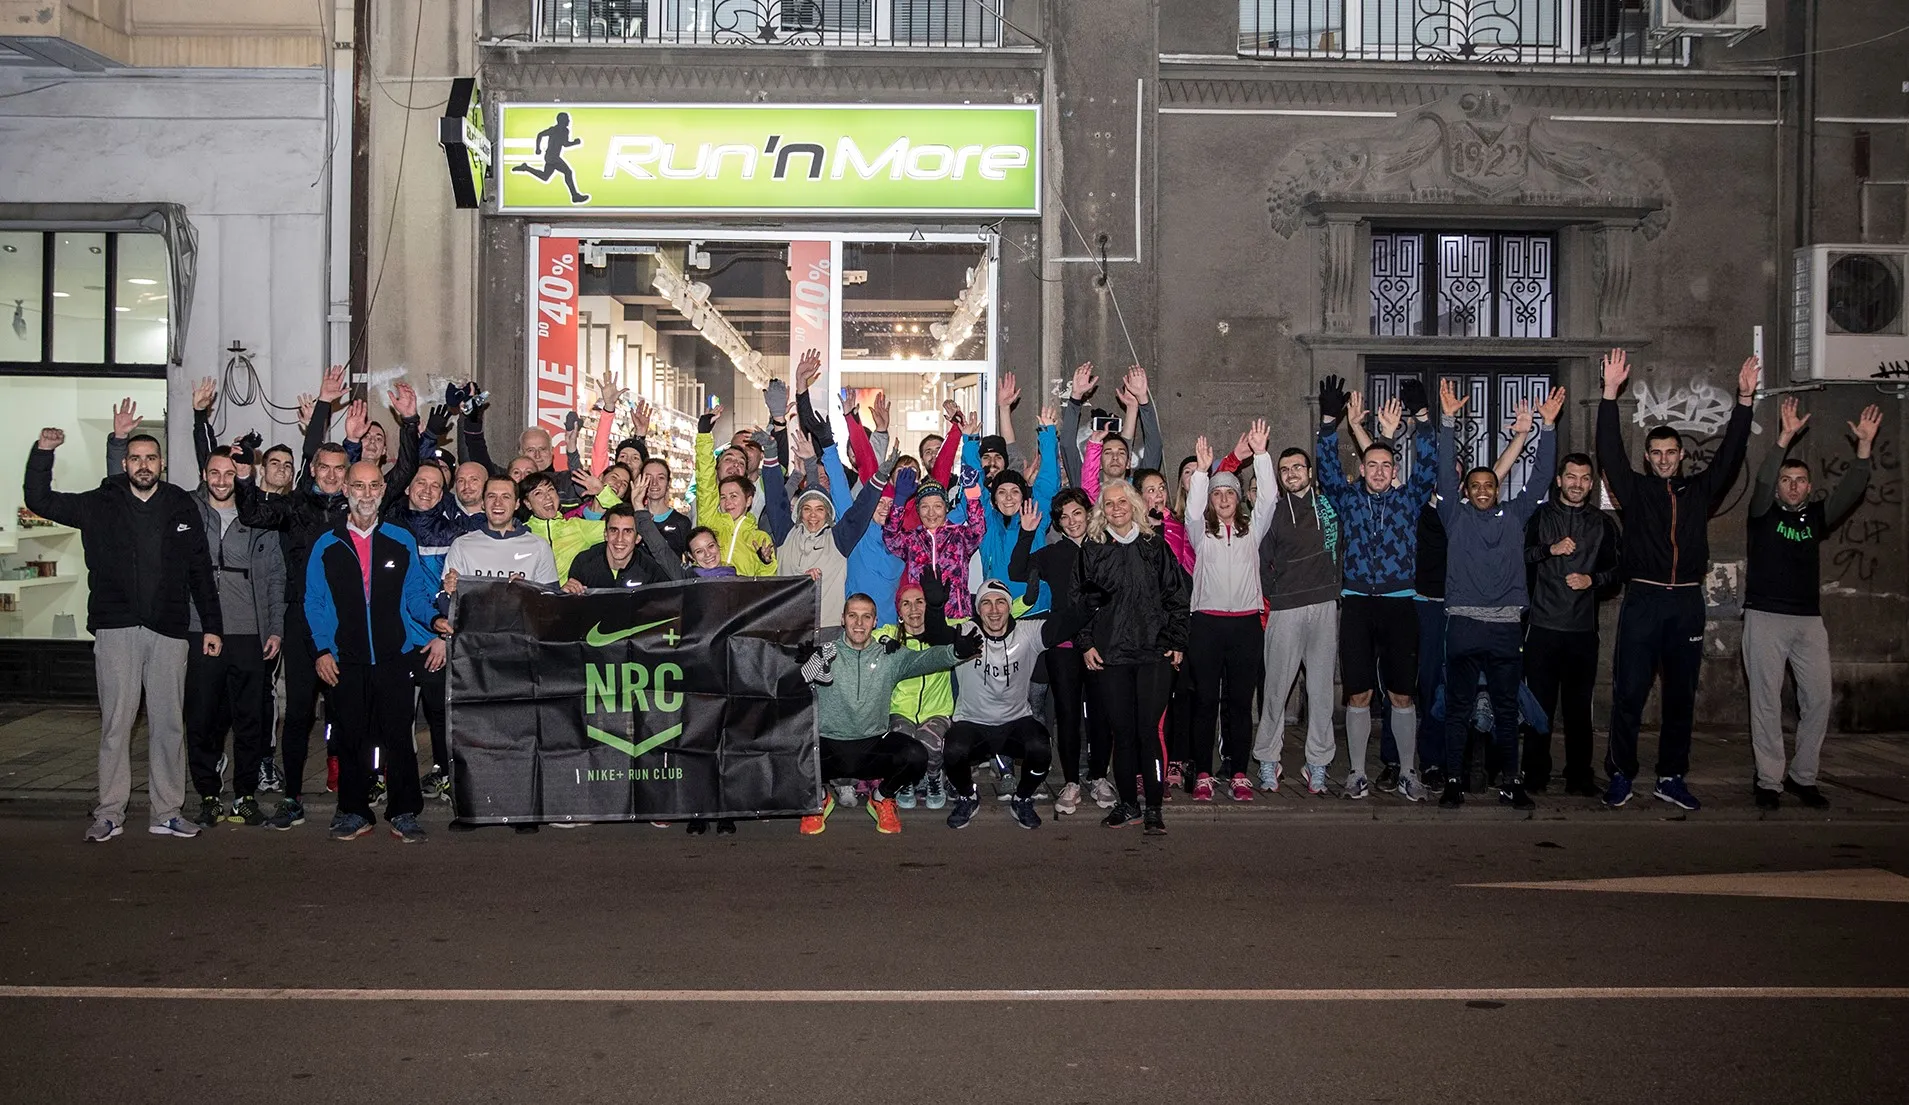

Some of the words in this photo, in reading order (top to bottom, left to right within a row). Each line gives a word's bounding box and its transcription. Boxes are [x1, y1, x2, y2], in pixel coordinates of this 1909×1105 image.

[538, 253, 574, 325] 40%
[795, 258, 830, 330] 40%
[538, 321, 549, 338] DO
[974, 659, 1019, 677] PACER
[585, 662, 684, 714] NRC
[587, 769, 624, 781] NIKE+
[628, 769, 649, 780] RUN
[653, 767, 683, 780] CLUB
